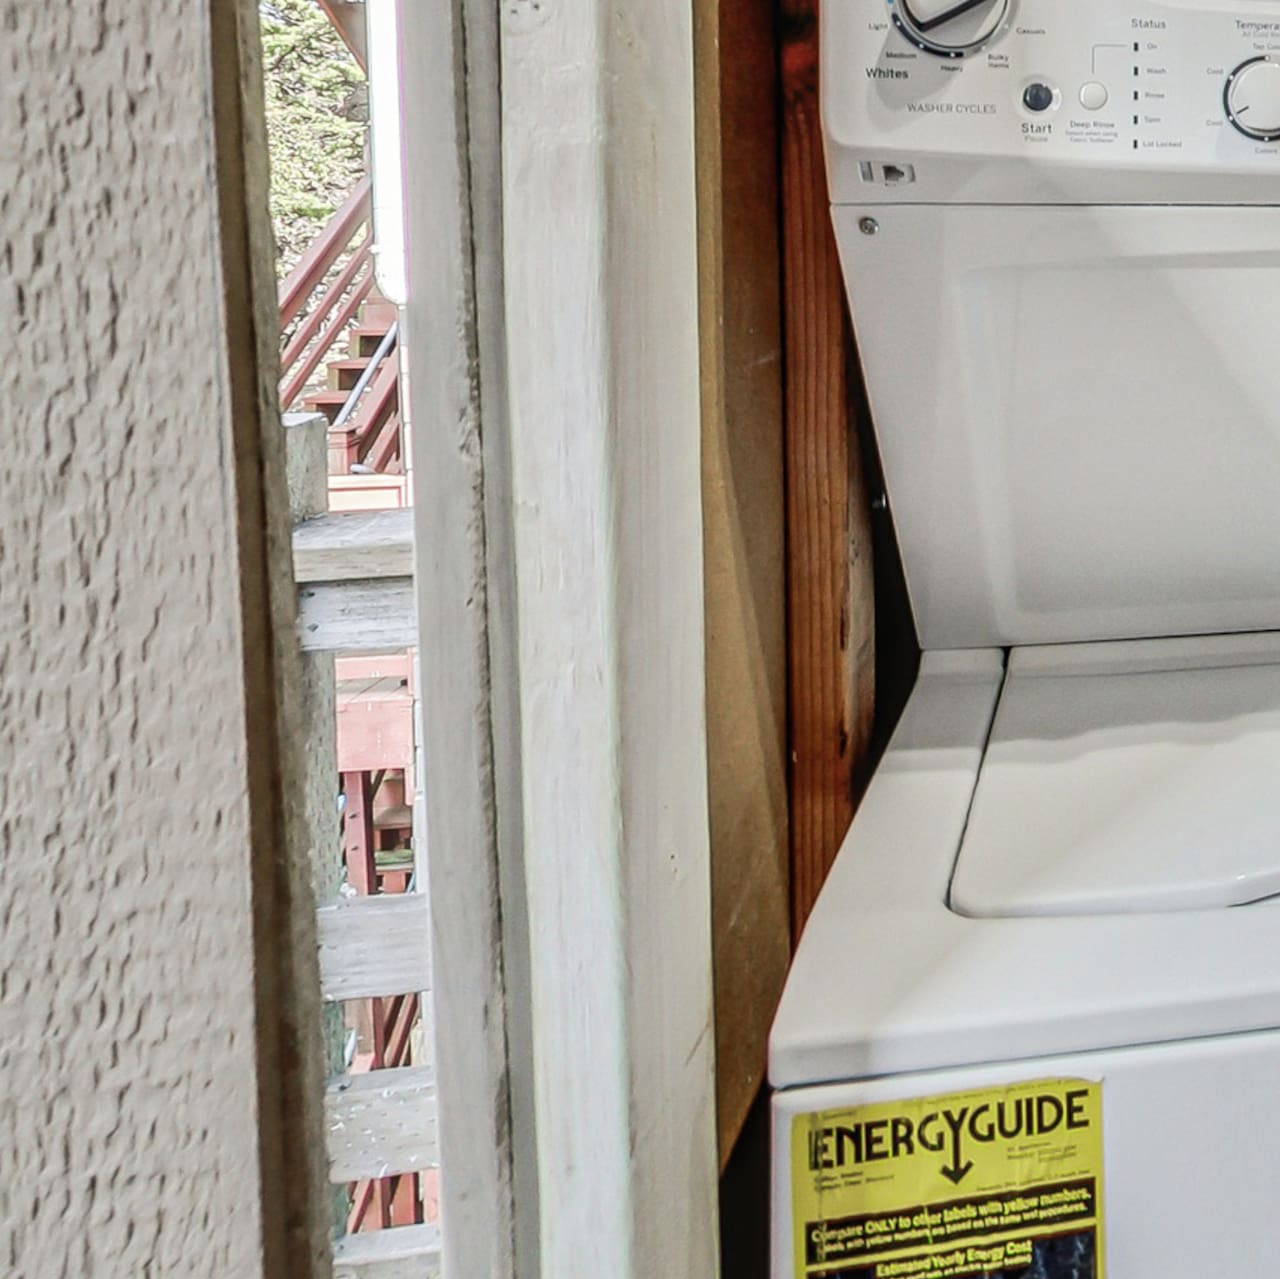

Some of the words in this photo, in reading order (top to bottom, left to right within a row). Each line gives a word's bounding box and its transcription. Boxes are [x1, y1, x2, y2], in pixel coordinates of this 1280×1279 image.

[1131, 19, 1166, 29] Status
[866, 68, 909, 79] Whites
[907, 103, 953, 113] WASHER
[956, 104, 996, 114] CYCLES
[1021, 123, 1052, 134] Start
[809, 1088, 1089, 1171] ENERGYGUIDE
[865, 1218, 897, 1234] ONLY
[899, 1216, 911, 1229] to
[1004, 1196, 1038, 1215] yellow
[967, 1246, 1004, 1262] Energy
[1006, 1240, 1032, 1255] Cost
